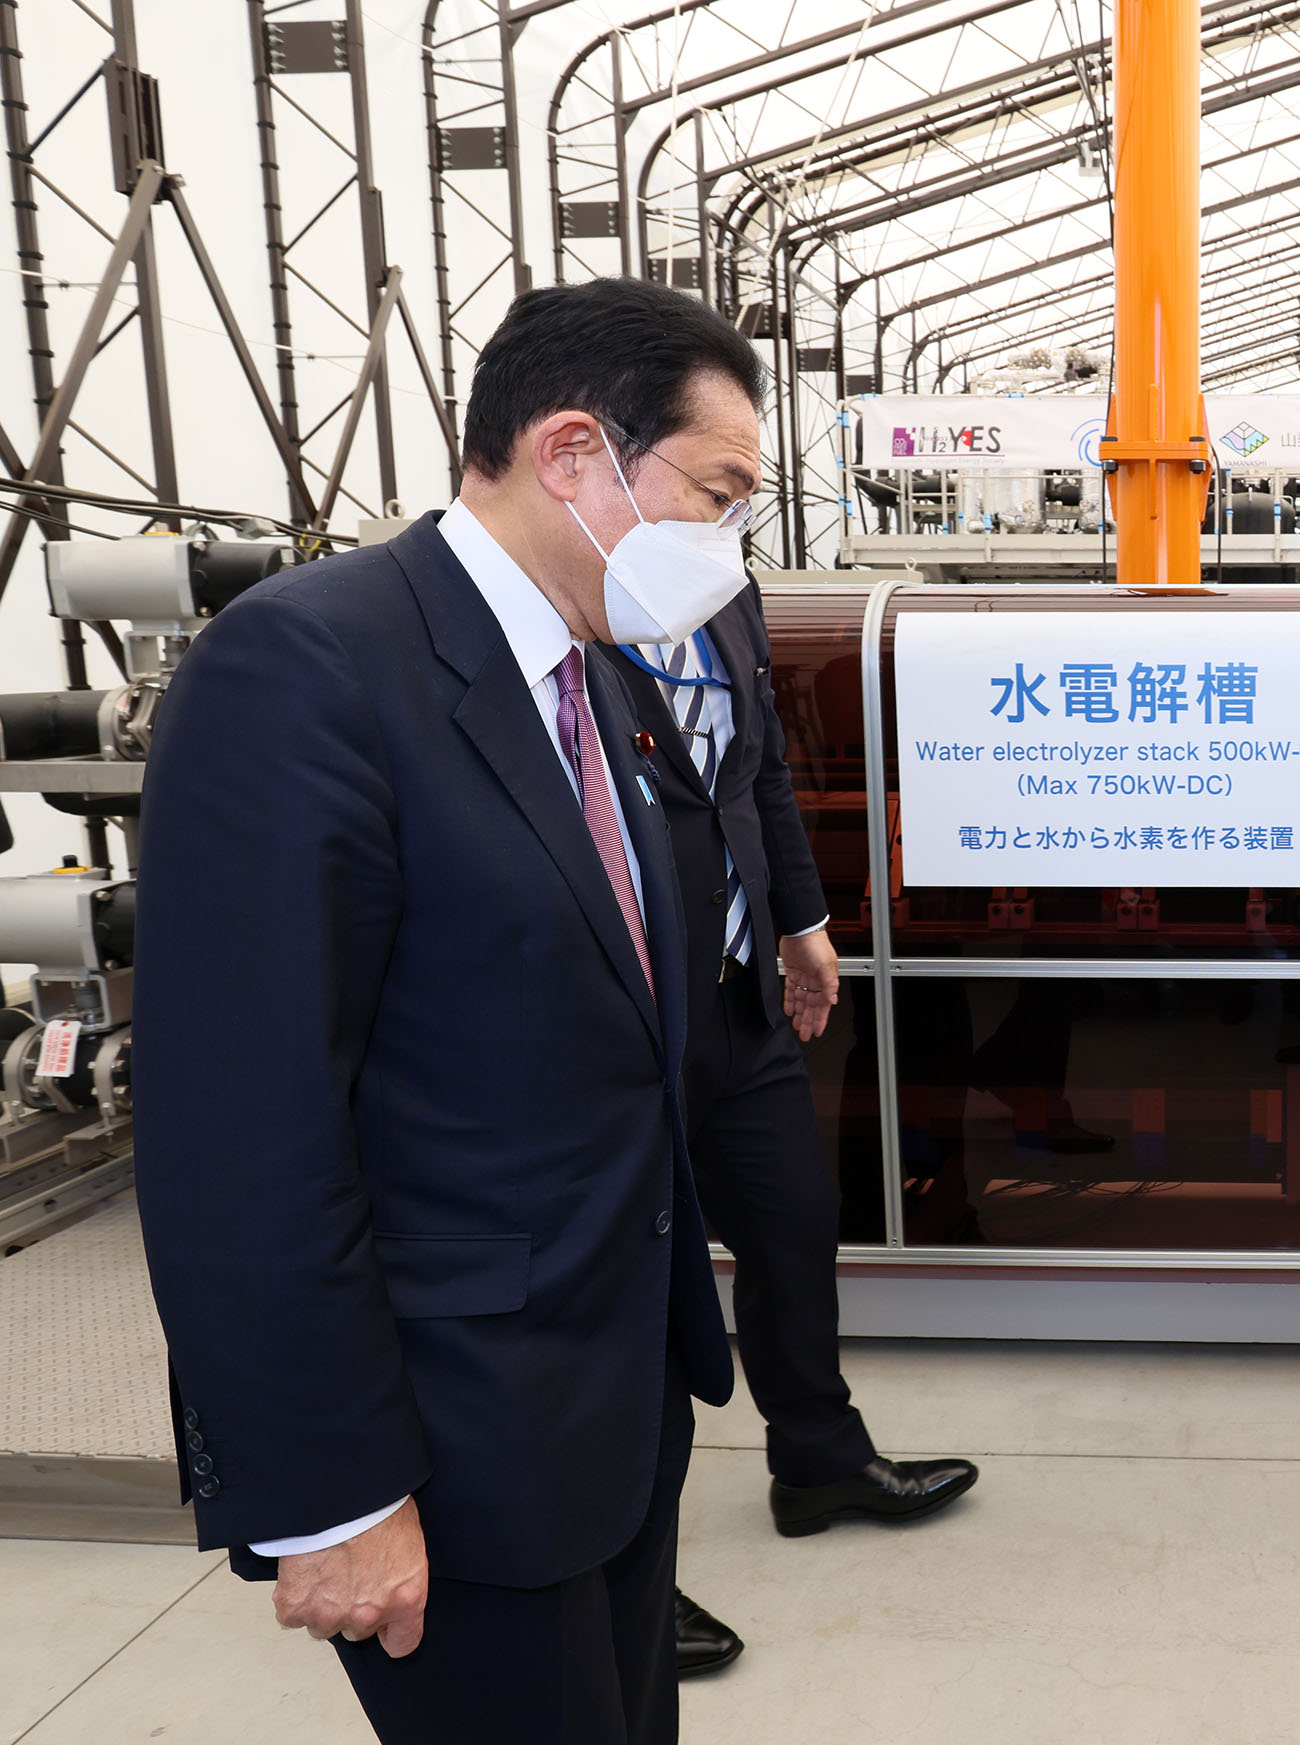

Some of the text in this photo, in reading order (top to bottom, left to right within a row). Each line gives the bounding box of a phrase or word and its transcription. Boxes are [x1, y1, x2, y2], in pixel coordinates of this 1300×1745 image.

[1224, 460, 1267, 468] YAMANASHI
[989, 662, 1259, 725] 水電解槽
[915, 741, 985, 761] Water
[992, 741, 1129, 766] electrolyzer
[1136, 741, 1200, 761] stack
[1017, 774, 1233, 797] (Max 750kW-DC)
[957, 824, 1295, 852] 電力と水から水素を作る装置
